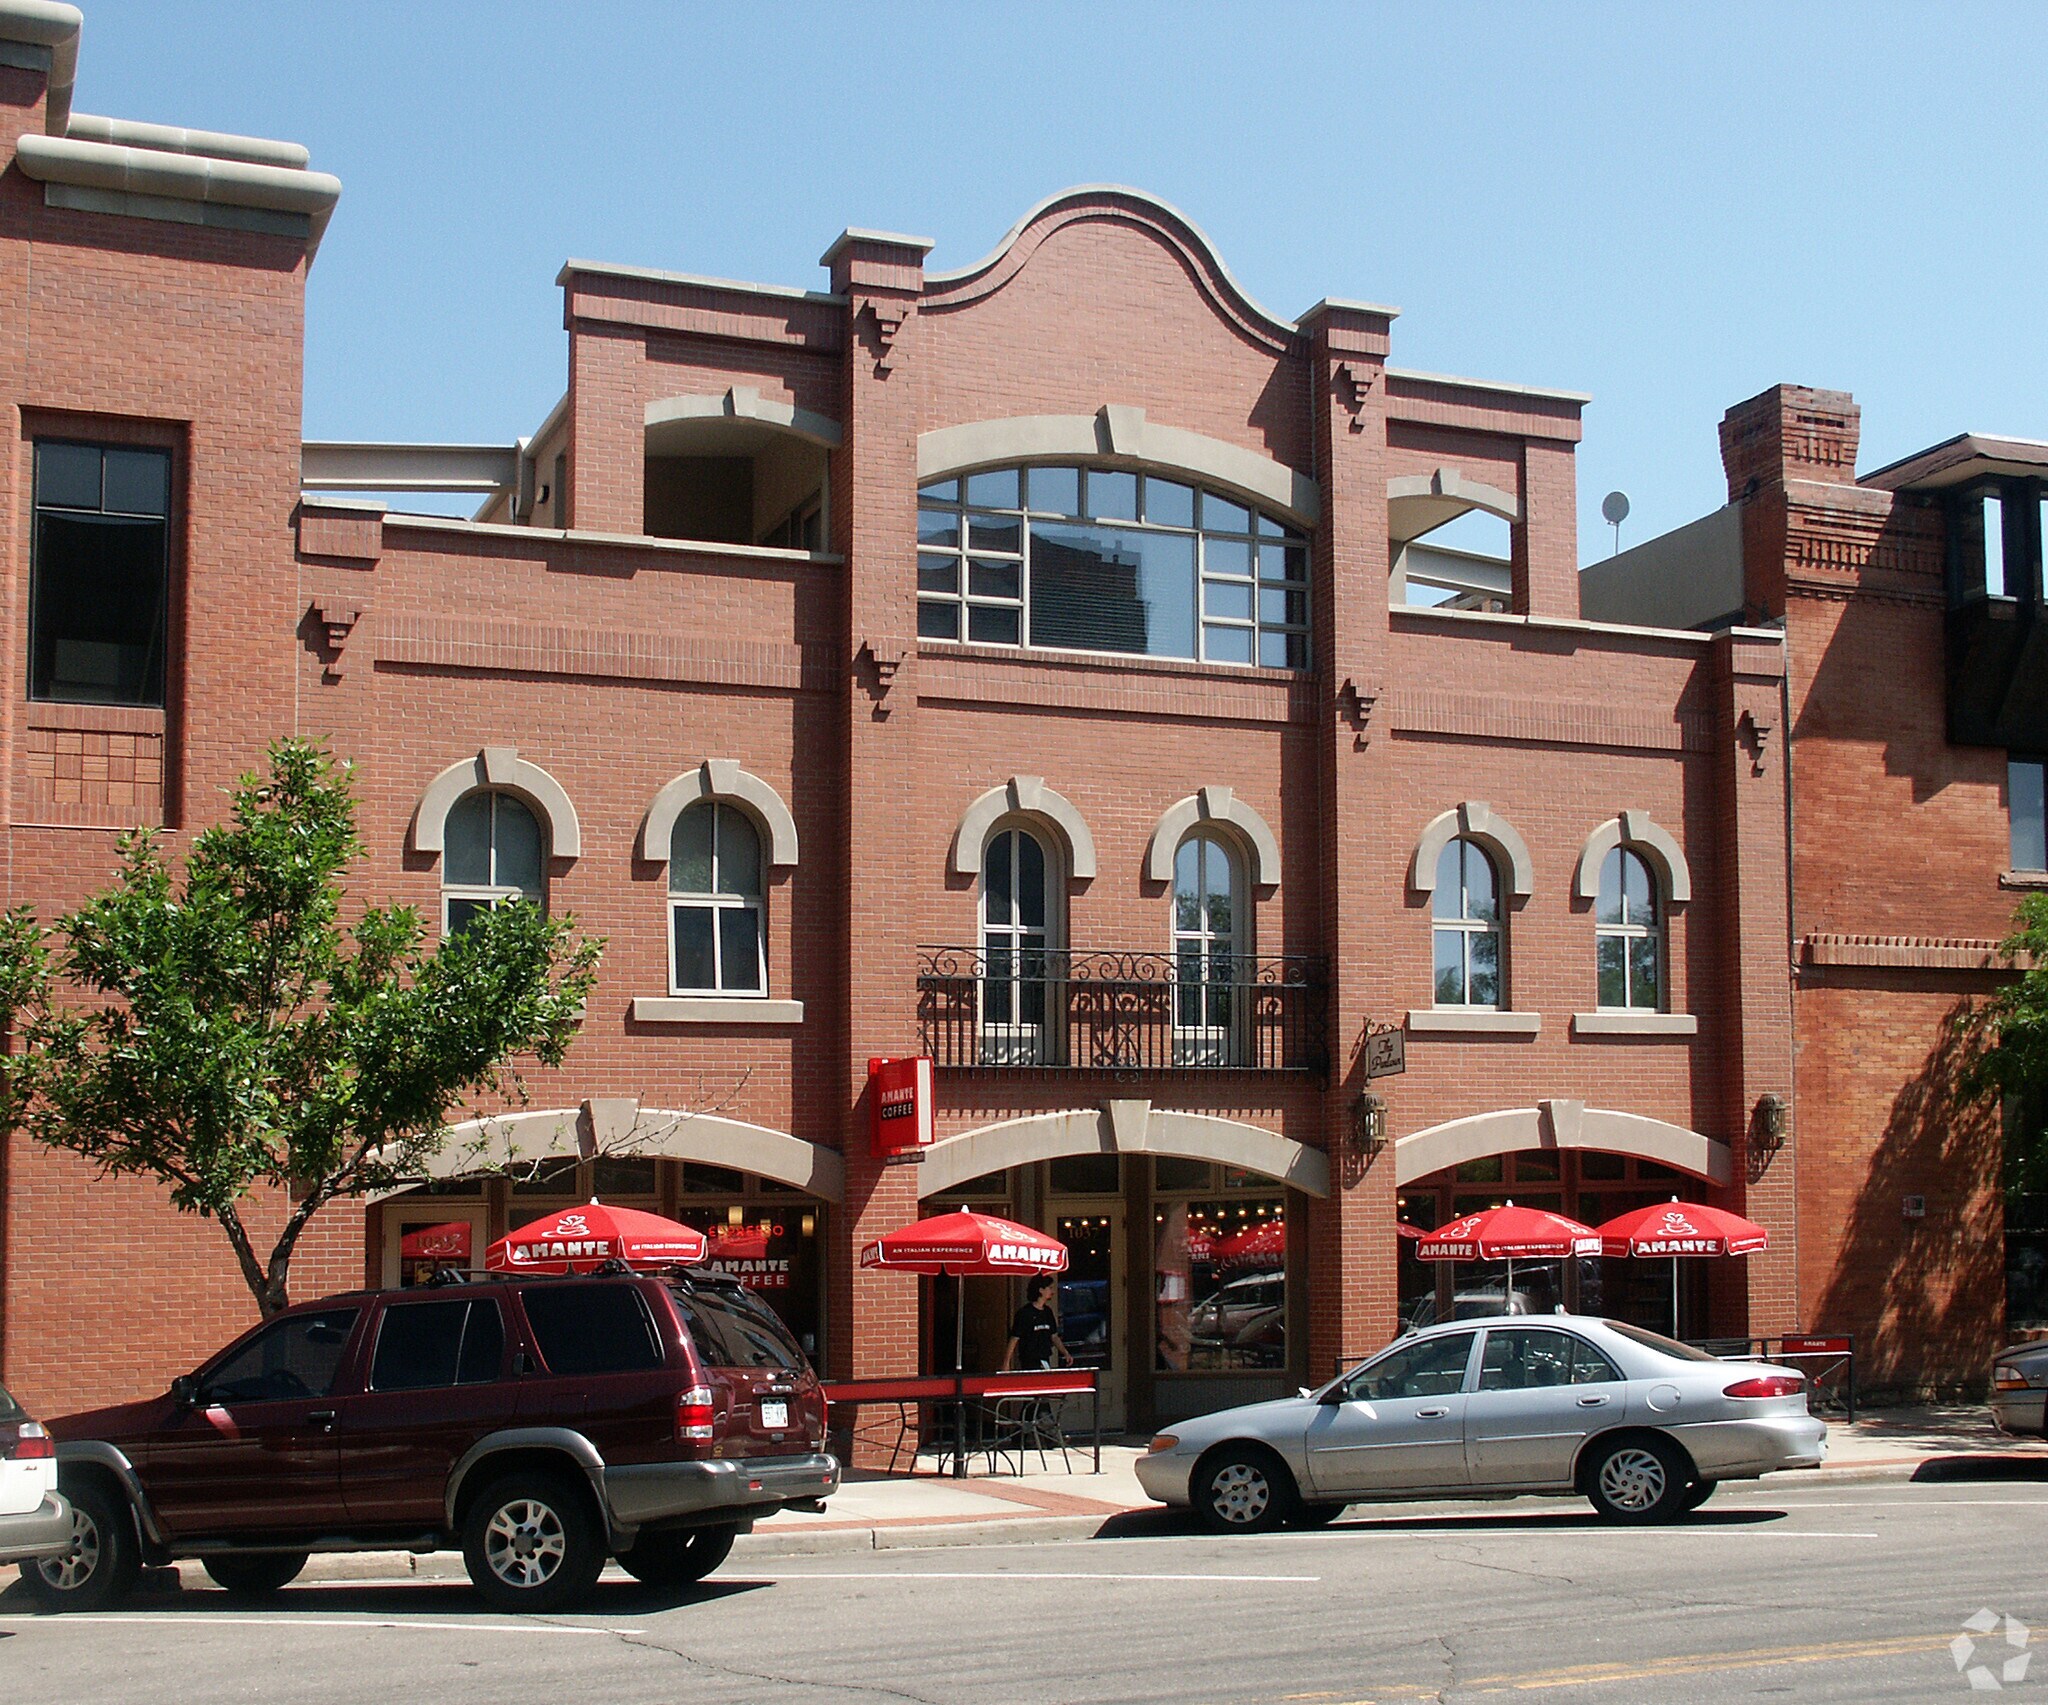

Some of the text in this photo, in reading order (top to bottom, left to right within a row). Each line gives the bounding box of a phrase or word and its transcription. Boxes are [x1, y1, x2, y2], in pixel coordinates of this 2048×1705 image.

[881, 1086, 913, 1104] AMANTE
[881, 1102, 913, 1118] COFFEE
[513, 1240, 609, 1260] AMANTE
[989, 1244, 1060, 1264] AMANTE
[1420, 1244, 1473, 1256] AMANTE
[1636, 1240, 1717, 1254] AMANTE
[711, 1260, 790, 1273] AMANTE
[740, 1275, 785, 1286] FFEE
